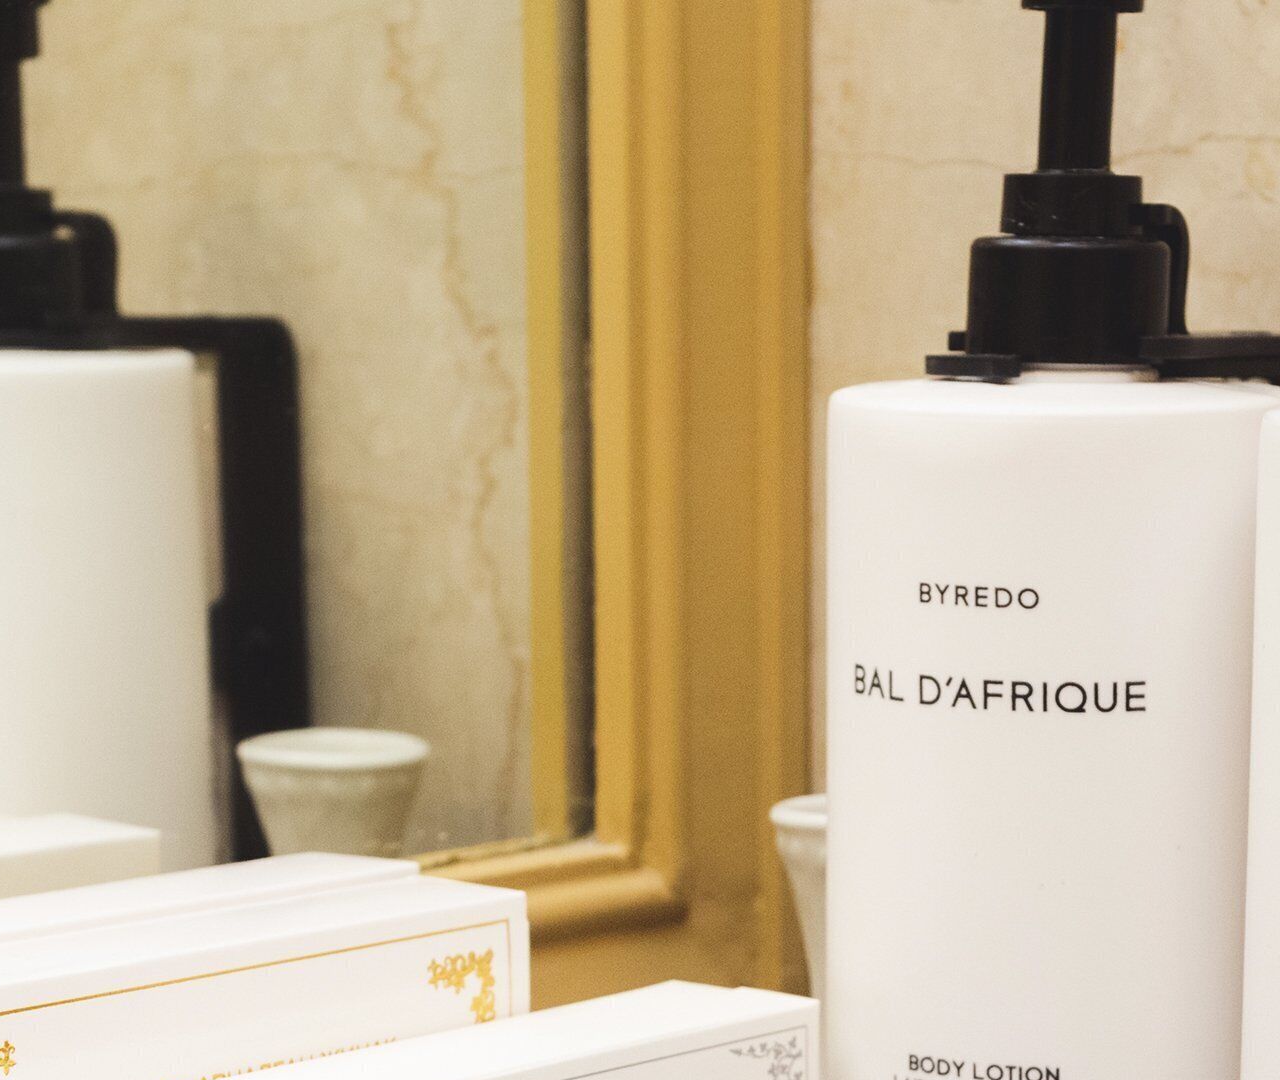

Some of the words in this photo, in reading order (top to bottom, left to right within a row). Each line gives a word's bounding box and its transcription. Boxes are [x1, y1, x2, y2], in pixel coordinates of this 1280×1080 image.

[919, 582, 1040, 609] BYREDO
[854, 663, 905, 702] BAL
[908, 1054, 965, 1078] BODY
